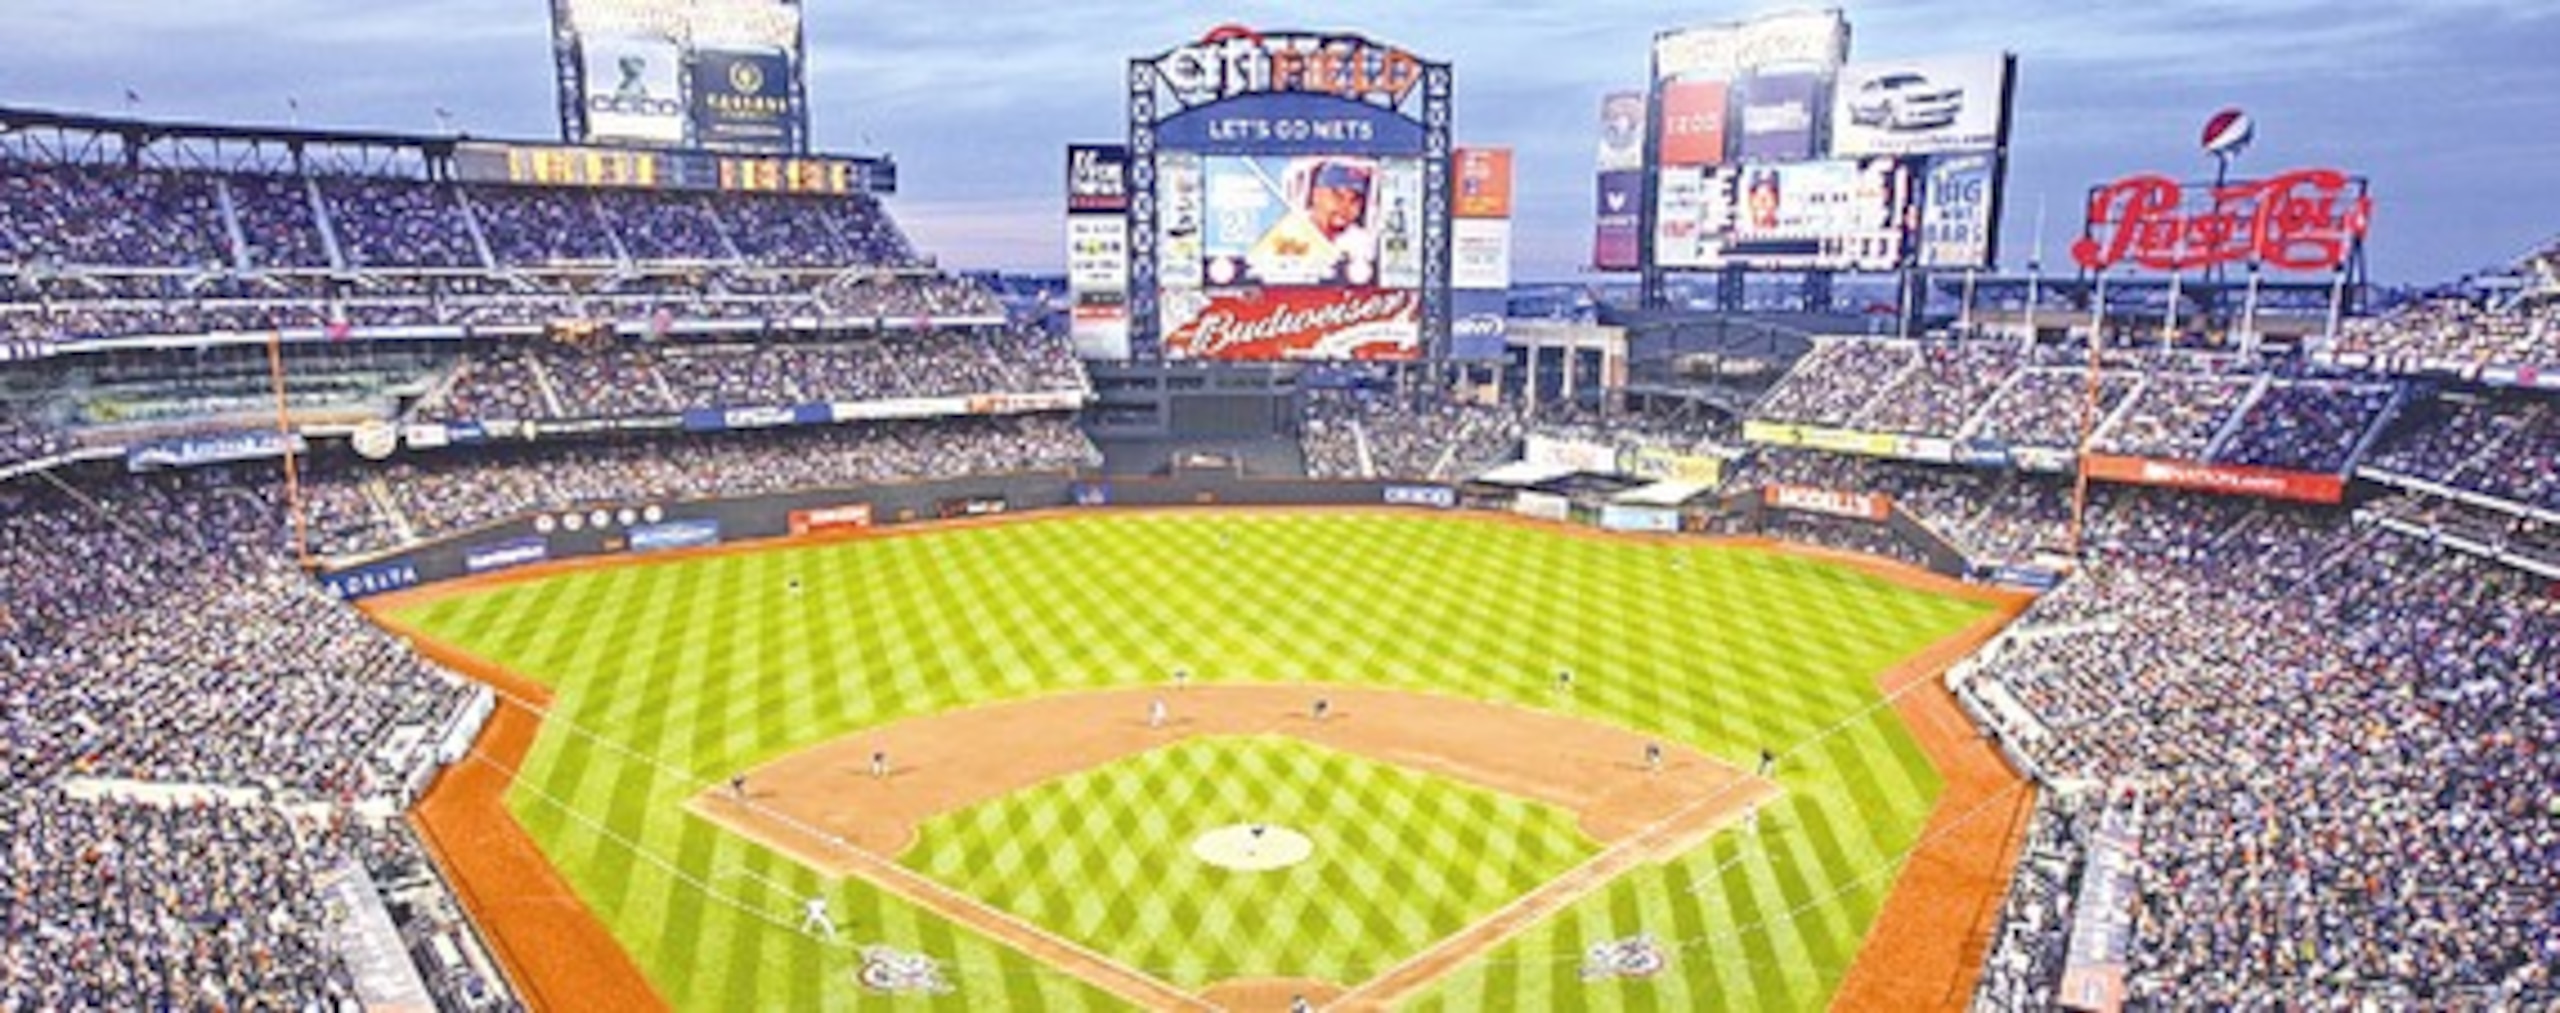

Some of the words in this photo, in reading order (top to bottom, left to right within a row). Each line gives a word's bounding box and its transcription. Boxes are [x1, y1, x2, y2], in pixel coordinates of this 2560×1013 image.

[1271, 42, 1419, 95] FIELD
[1208, 119, 1270, 140] LET'S
[1273, 120, 1311, 139] GO
[1312, 119, 1375, 140] METS
[1189, 289, 1407, 351] Budweiser
[347, 565, 418, 594] DELTA
